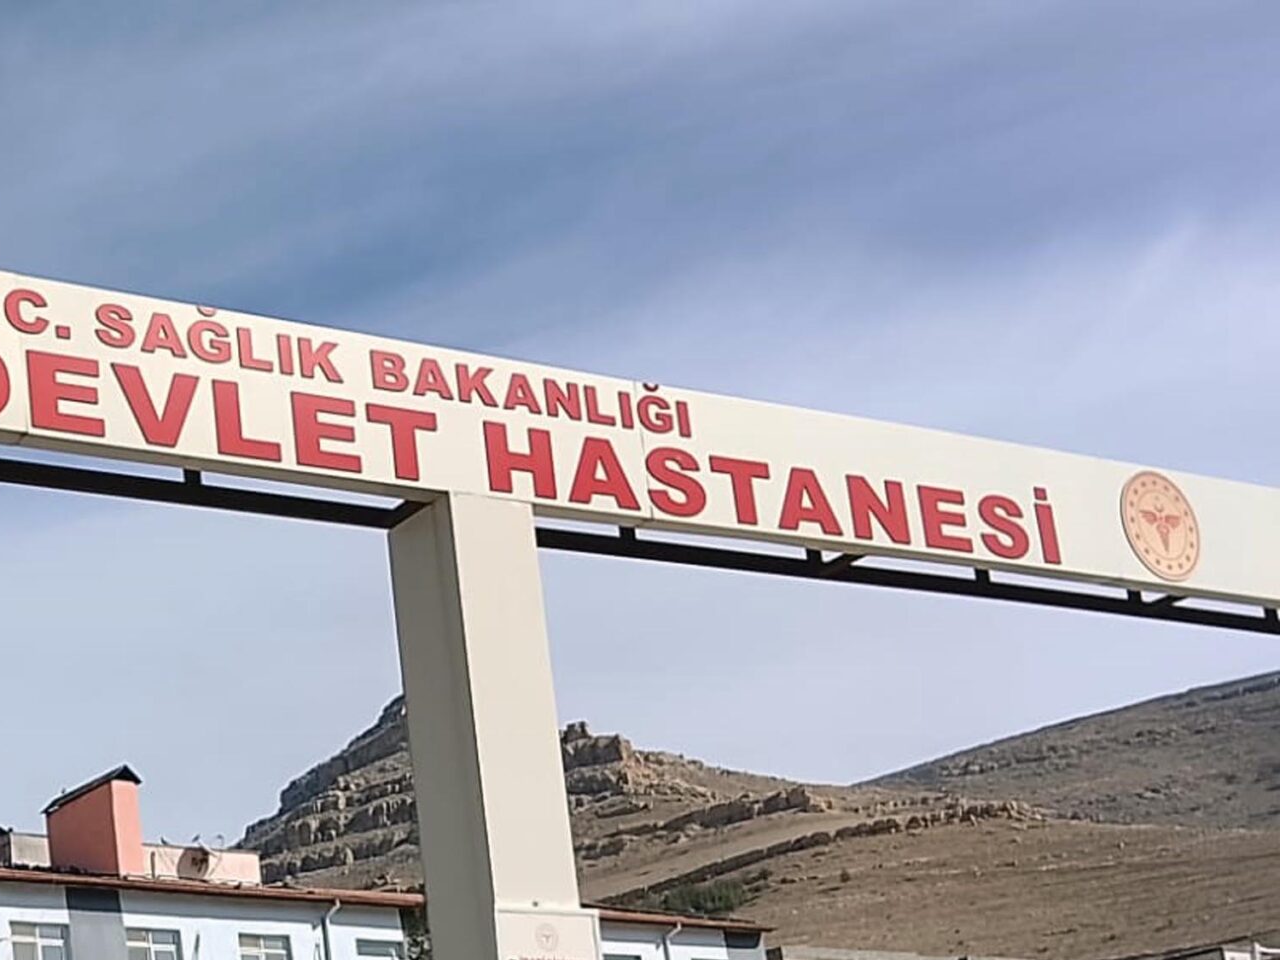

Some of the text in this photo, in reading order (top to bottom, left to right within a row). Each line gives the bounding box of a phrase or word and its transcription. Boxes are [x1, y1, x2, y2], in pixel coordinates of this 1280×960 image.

[95, 303, 344, 384] SAĞLIK
[369, 349, 693, 439] BAKANLIĞI
[482, 420, 1063, 565] HASTANESİ
